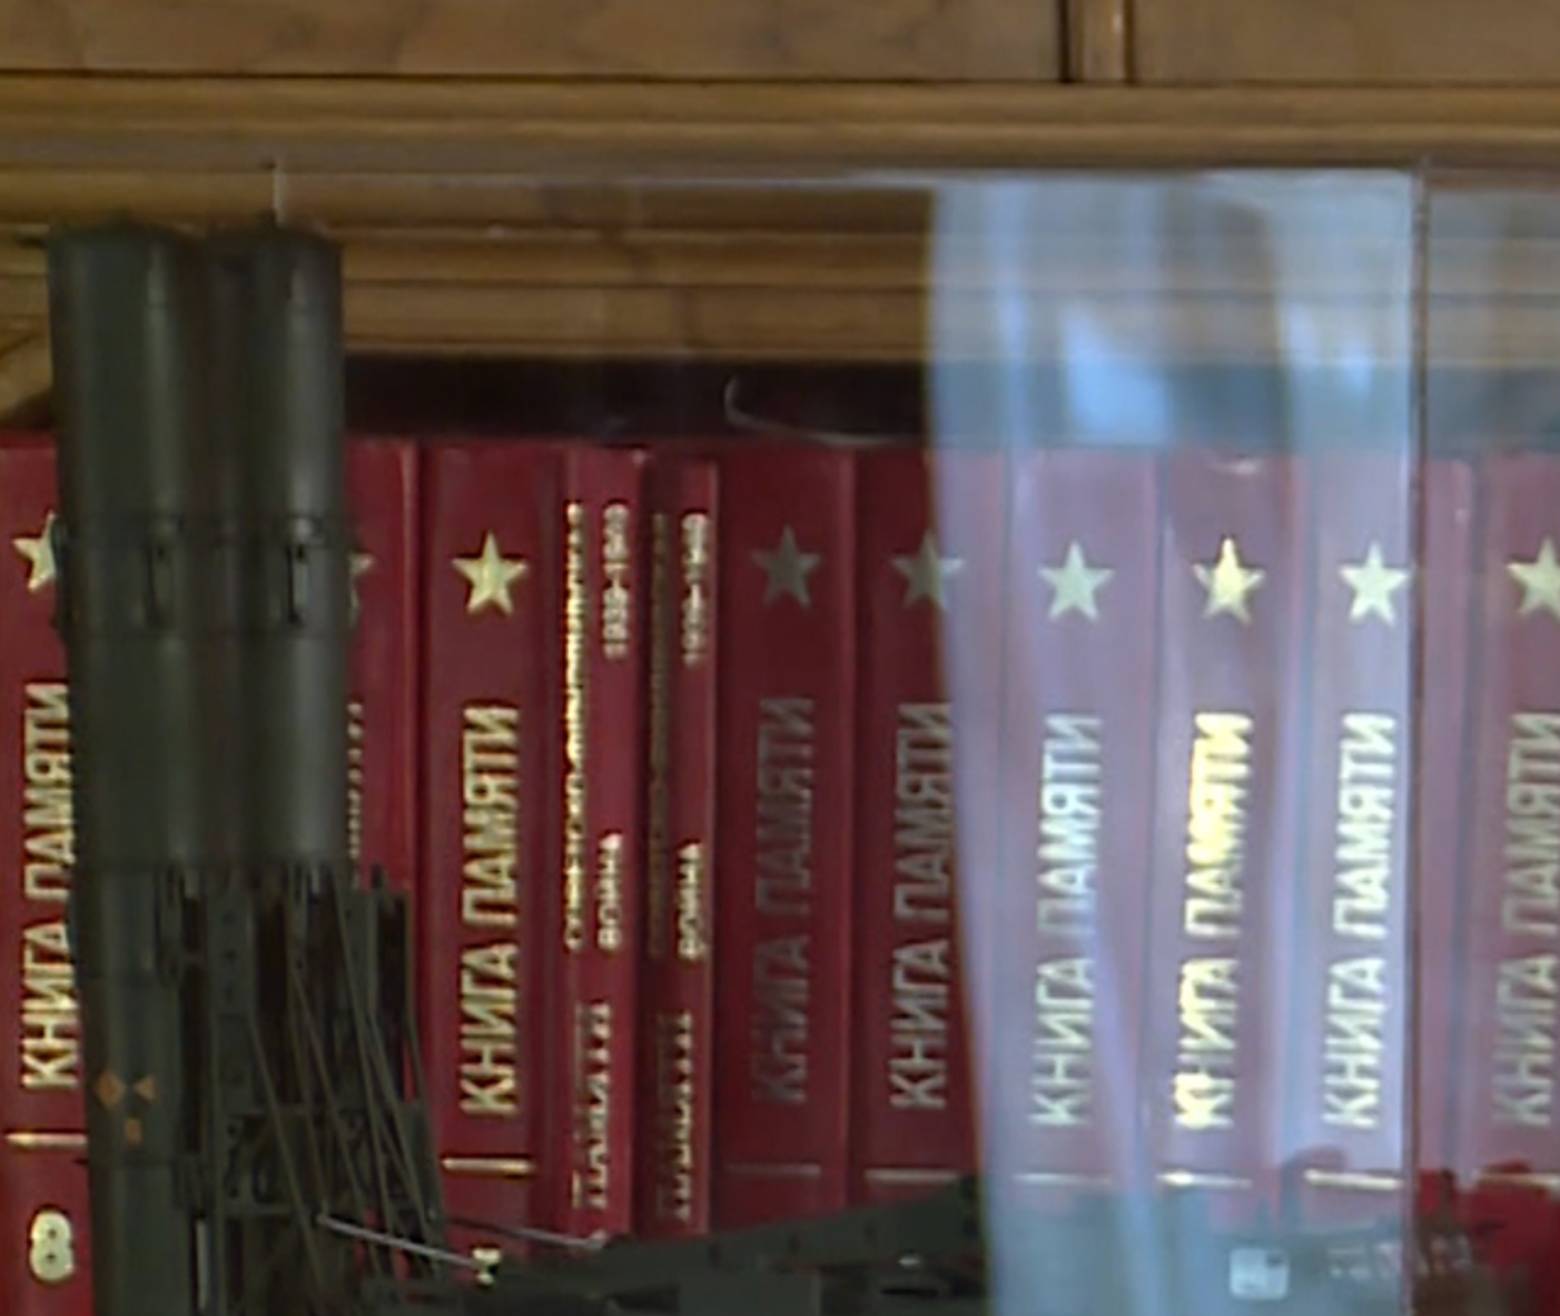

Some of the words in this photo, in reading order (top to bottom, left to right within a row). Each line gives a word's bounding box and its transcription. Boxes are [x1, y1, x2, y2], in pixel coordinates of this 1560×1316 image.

[24, 682, 76, 900] ПАМЯТИ
[462, 706, 518, 927] ПАМЯТИ
[756, 697, 814, 915] ПАМЯТИ
[894, 703, 952, 924] ПАМЯТИ
[1036, 713, 1102, 937] ПАМЯТИ
[1185, 712, 1253, 937] ПАМЯТИ
[1333, 713, 1396, 938] ПАМЯТИ
[22, 922, 78, 1090] КНИГА
[460, 945, 518, 1115] КНИГА
[752, 936, 808, 1104] КНИГА
[890, 939, 948, 1109] КНИГА
[1030, 956, 1096, 1127] КНИГА
[1174, 957, 1238, 1130] КНИГА
[1324, 957, 1386, 1128] КНИГА
[1496, 954, 1560, 1126] КНИГА
[30, 1209, 74, 1281] 8
